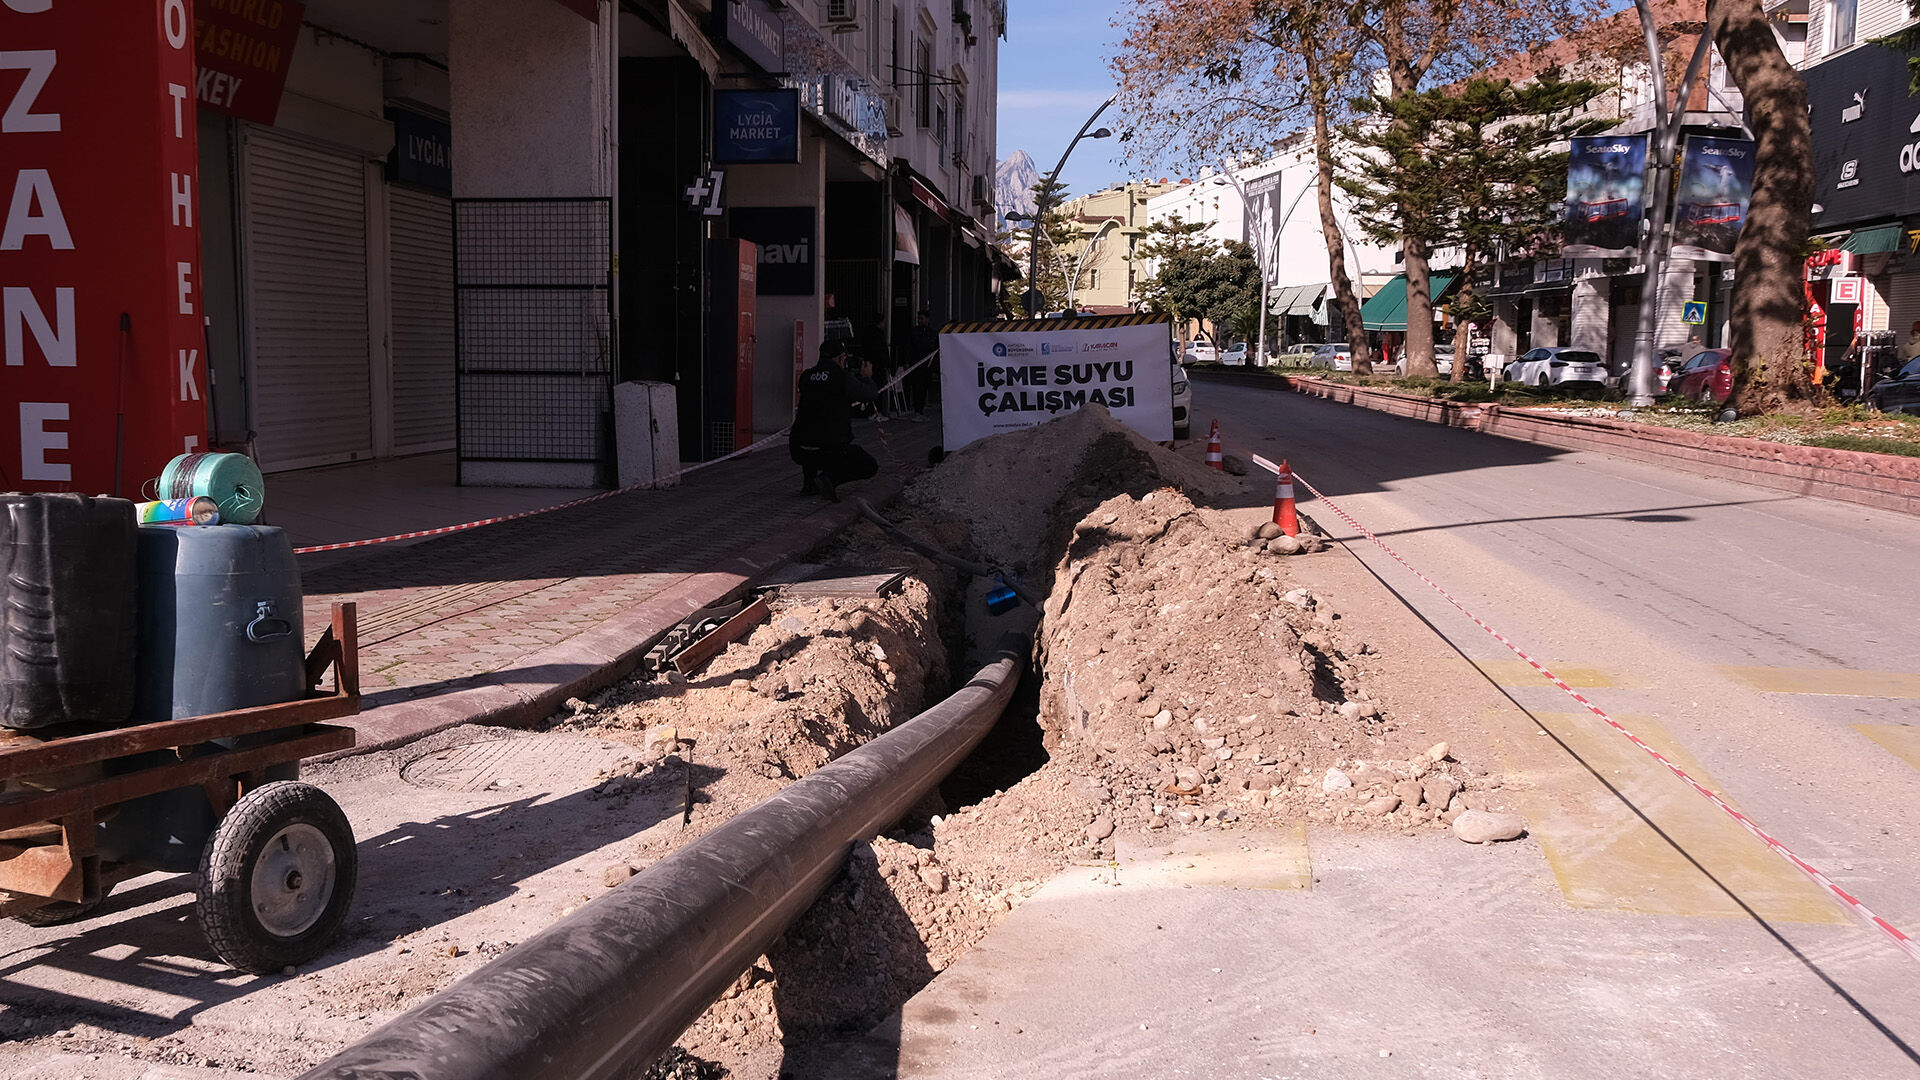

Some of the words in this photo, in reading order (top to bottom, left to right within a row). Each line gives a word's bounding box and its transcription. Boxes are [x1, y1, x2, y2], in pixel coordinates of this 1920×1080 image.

[209, 0, 283, 30] ORLD
[196, 66, 243, 108] KEY
[730, 127, 781, 140] MARKET
[737, 111, 774, 126] LYCİA
[409, 134, 444, 168] LYCİA
[0, 0, 77, 482] ZANE
[1839, 283, 1853, 298] E
[977, 362, 1047, 391] İÇME
[1054, 360, 1133, 386] SUYU
[978, 386, 1135, 416] ÇALIŞMASI
